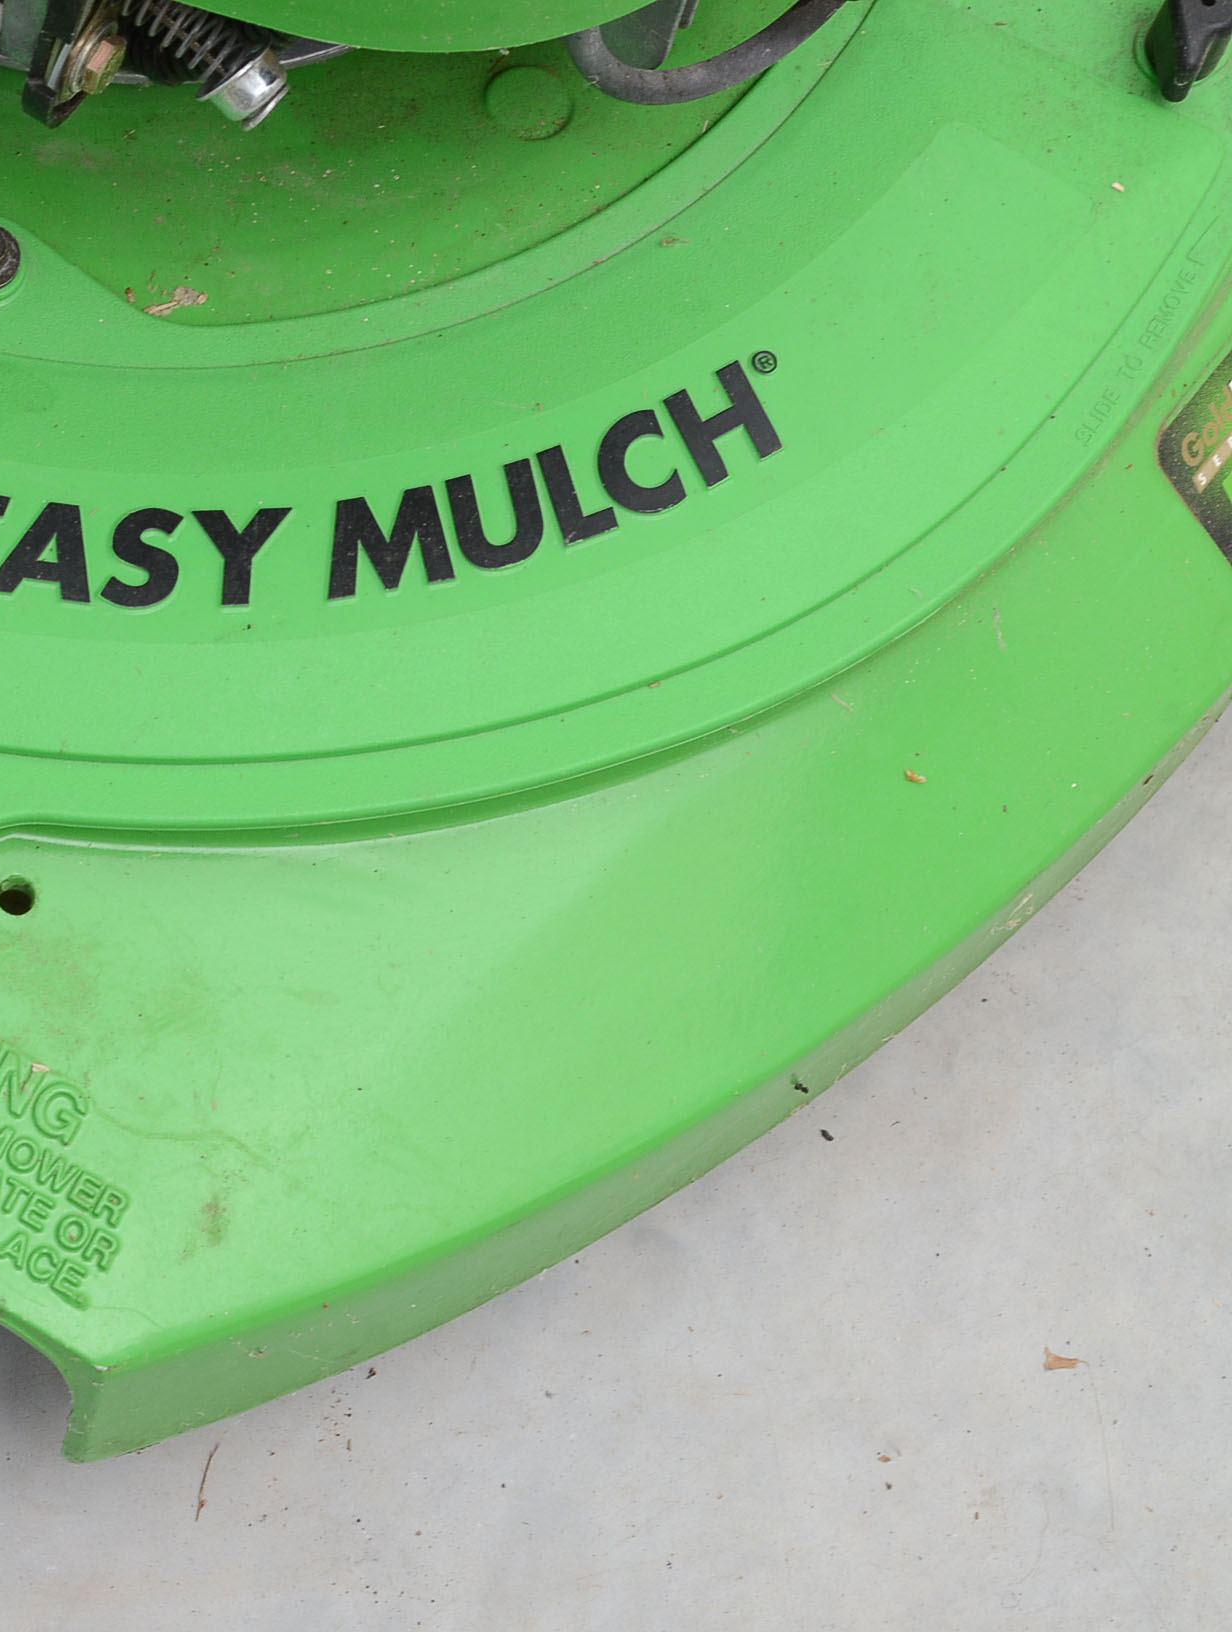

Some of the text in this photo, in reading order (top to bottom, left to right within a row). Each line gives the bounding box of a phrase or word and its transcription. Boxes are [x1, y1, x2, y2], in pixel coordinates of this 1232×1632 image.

[1116, 354, 1143, 380] TO
[1139, 269, 1196, 350] REMOVE
[56, 1215, 122, 1271] OR
